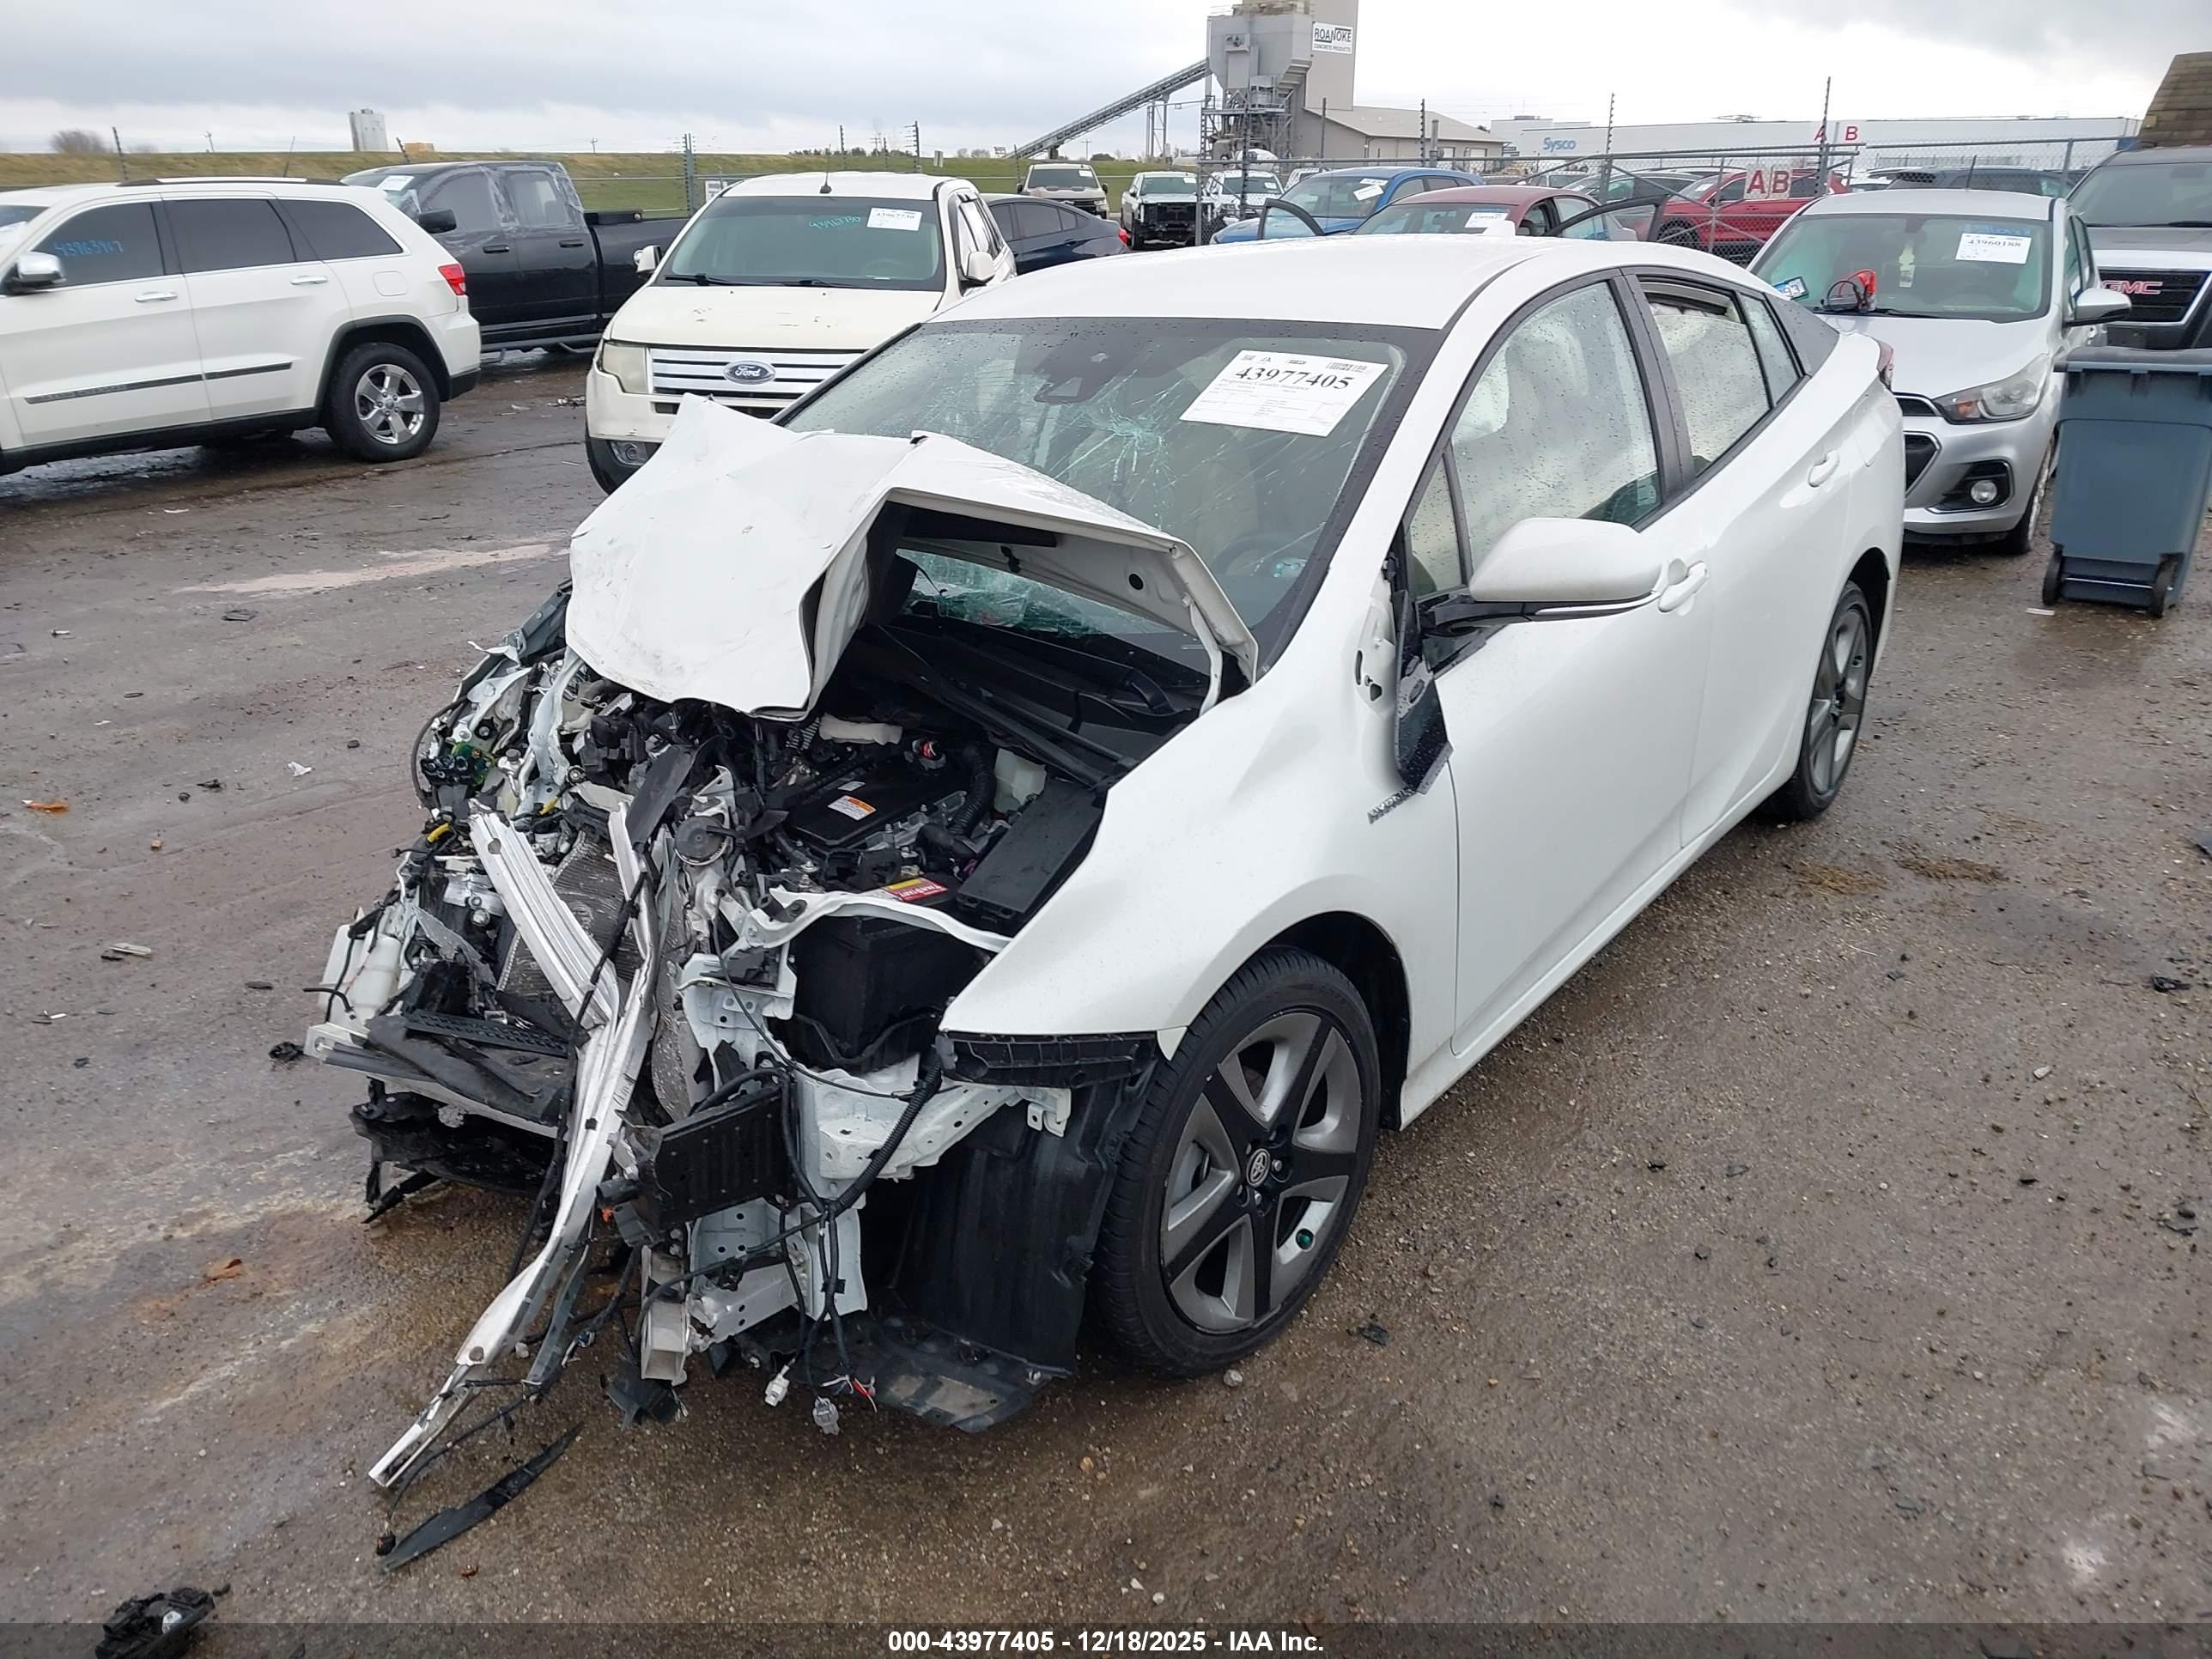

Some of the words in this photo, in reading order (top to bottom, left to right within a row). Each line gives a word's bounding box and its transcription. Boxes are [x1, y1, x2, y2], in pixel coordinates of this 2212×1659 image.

[1314, 27, 1352, 42] ROANOKE
[1845, 126, 1858, 141] B
[1543, 137, 1577, 153] Sysco
[1747, 170, 1766, 194] A
[1771, 170, 1790, 194] B
[2102, 279, 2164, 295] GMC
[734, 365, 762, 377] Ford
[1235, 366, 1356, 390] 43977405
